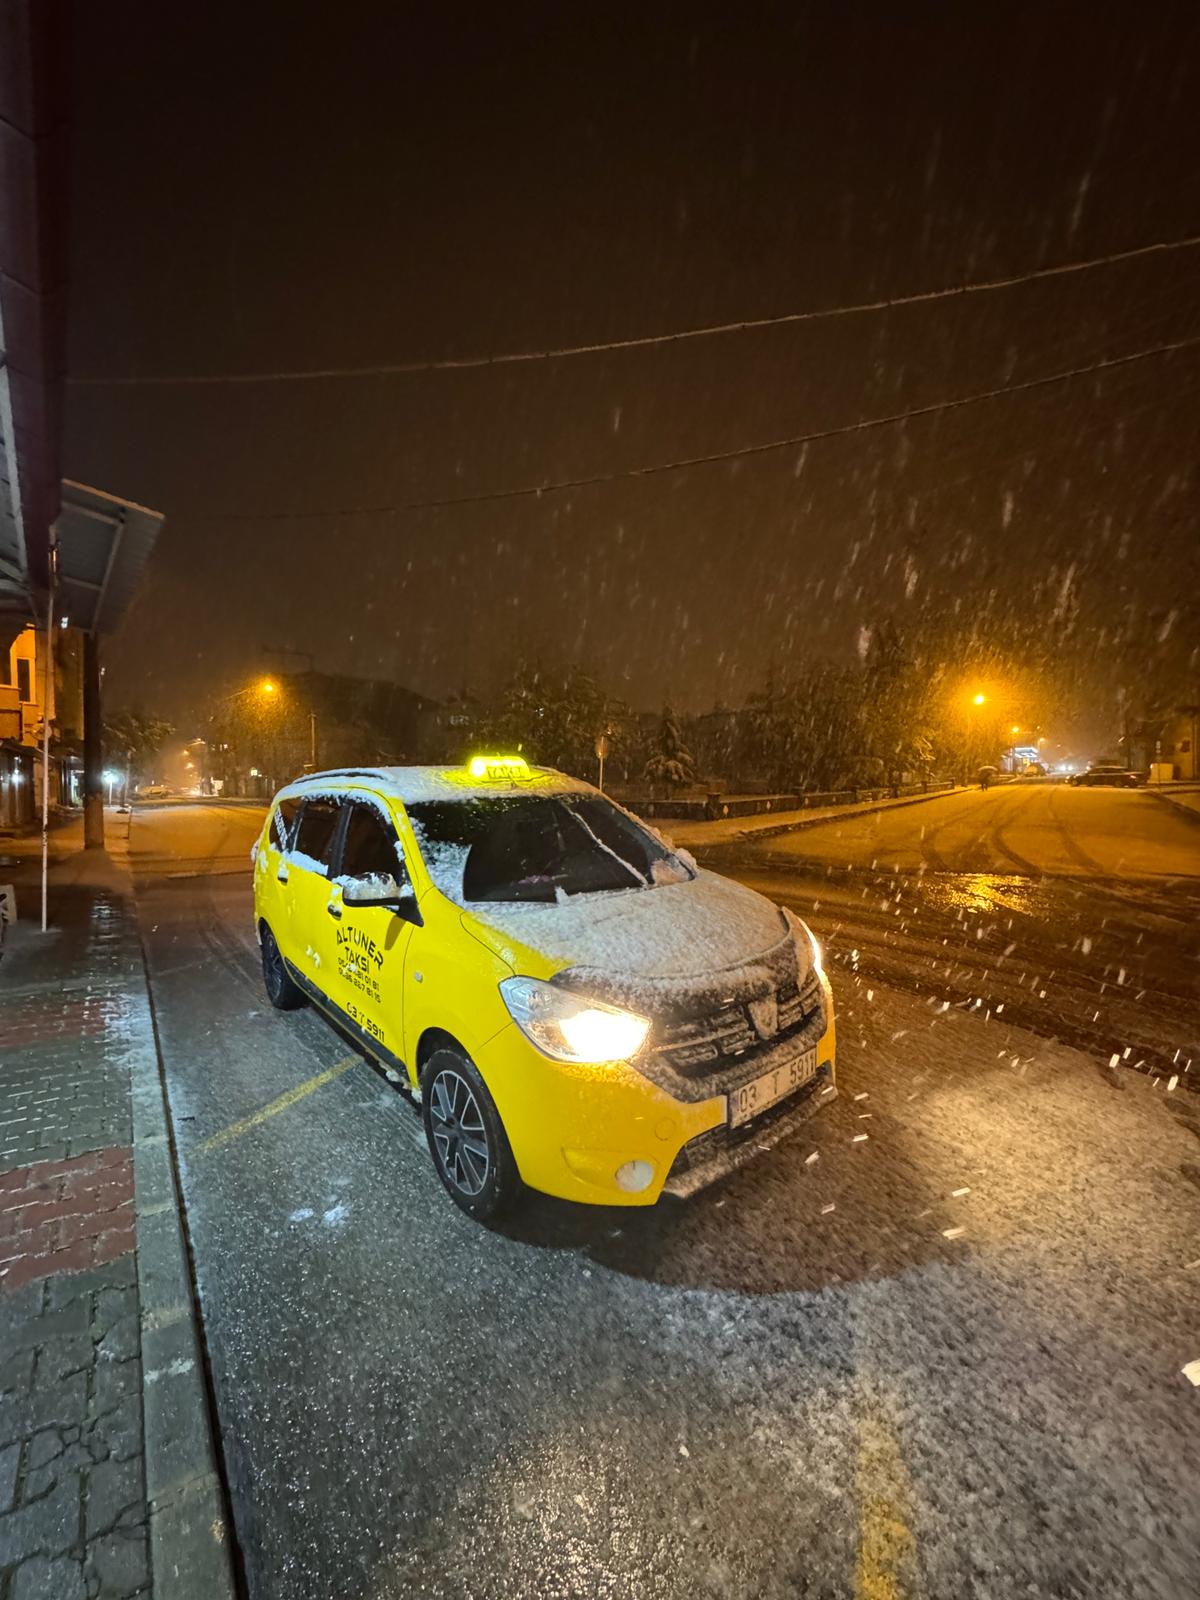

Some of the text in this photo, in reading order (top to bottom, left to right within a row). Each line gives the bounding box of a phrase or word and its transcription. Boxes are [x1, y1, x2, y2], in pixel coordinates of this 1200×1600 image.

[336, 926, 384, 970] ALTUNER
[366, 1018, 384, 1043] 5911
[740, 1054, 814, 1113] 03 T 5911
